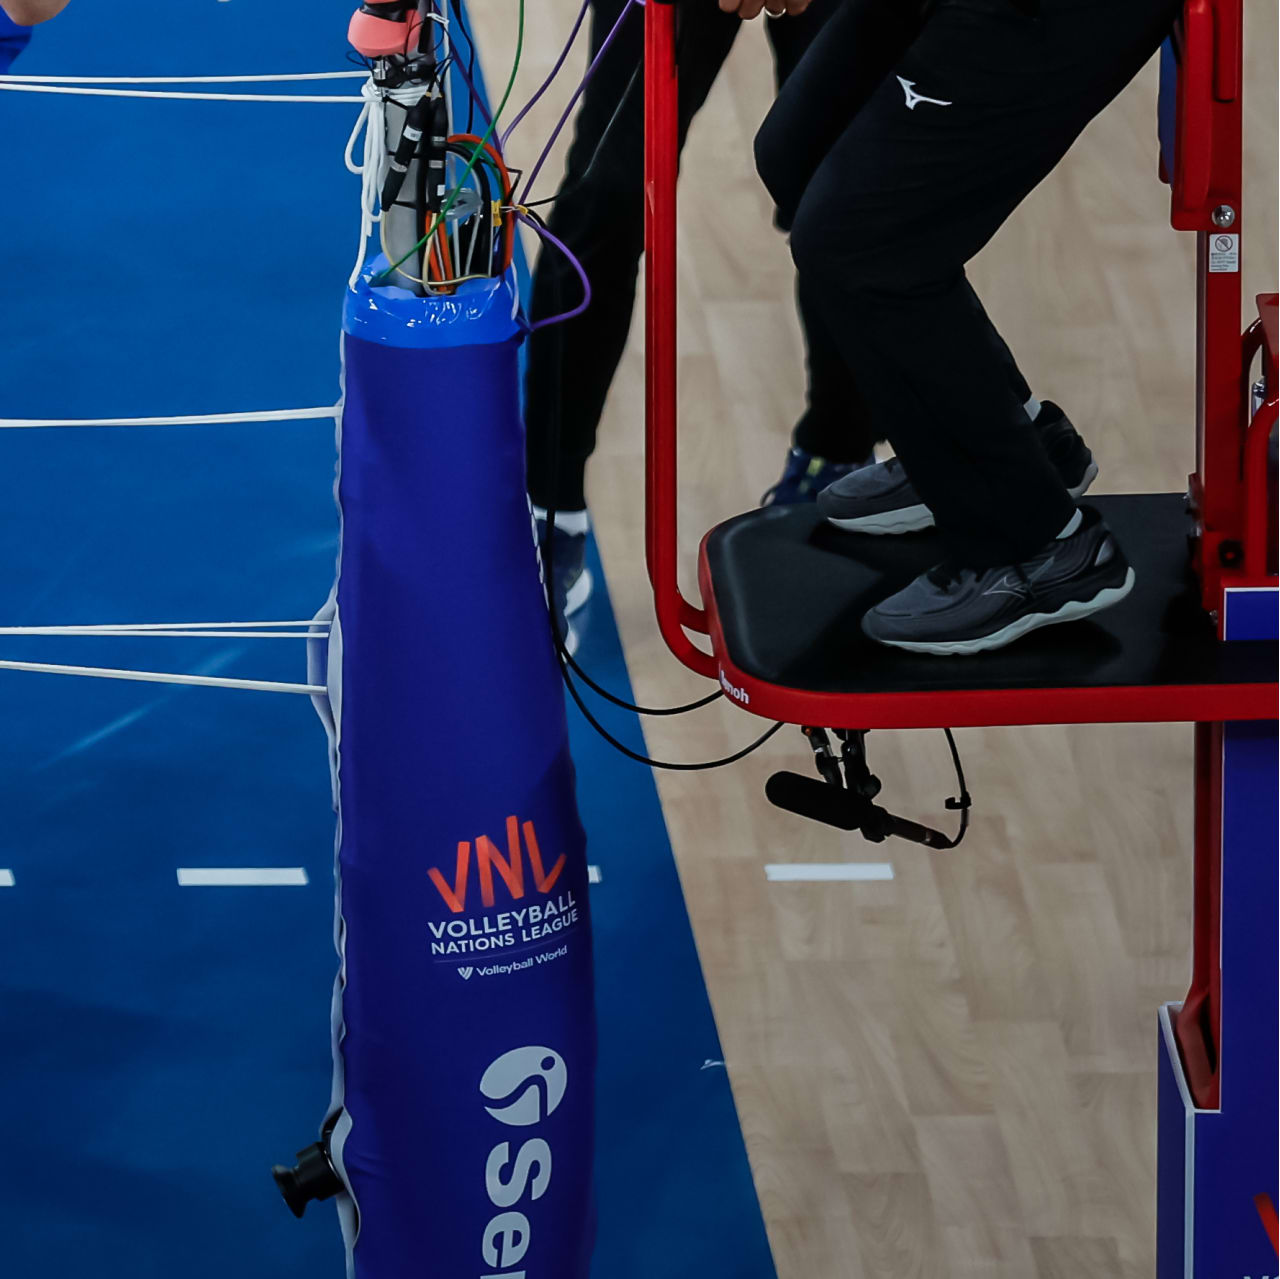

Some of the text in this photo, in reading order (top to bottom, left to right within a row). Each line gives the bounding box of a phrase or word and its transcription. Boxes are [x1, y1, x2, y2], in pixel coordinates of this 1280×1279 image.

[427, 815, 567, 913] VNL
[427, 891, 576, 939] VOLLEYBALL
[431, 908, 579, 956] NATIONS LEAGUE
[476, 944, 568, 976] Volleyball World
[482, 1137, 552, 1278] Se
